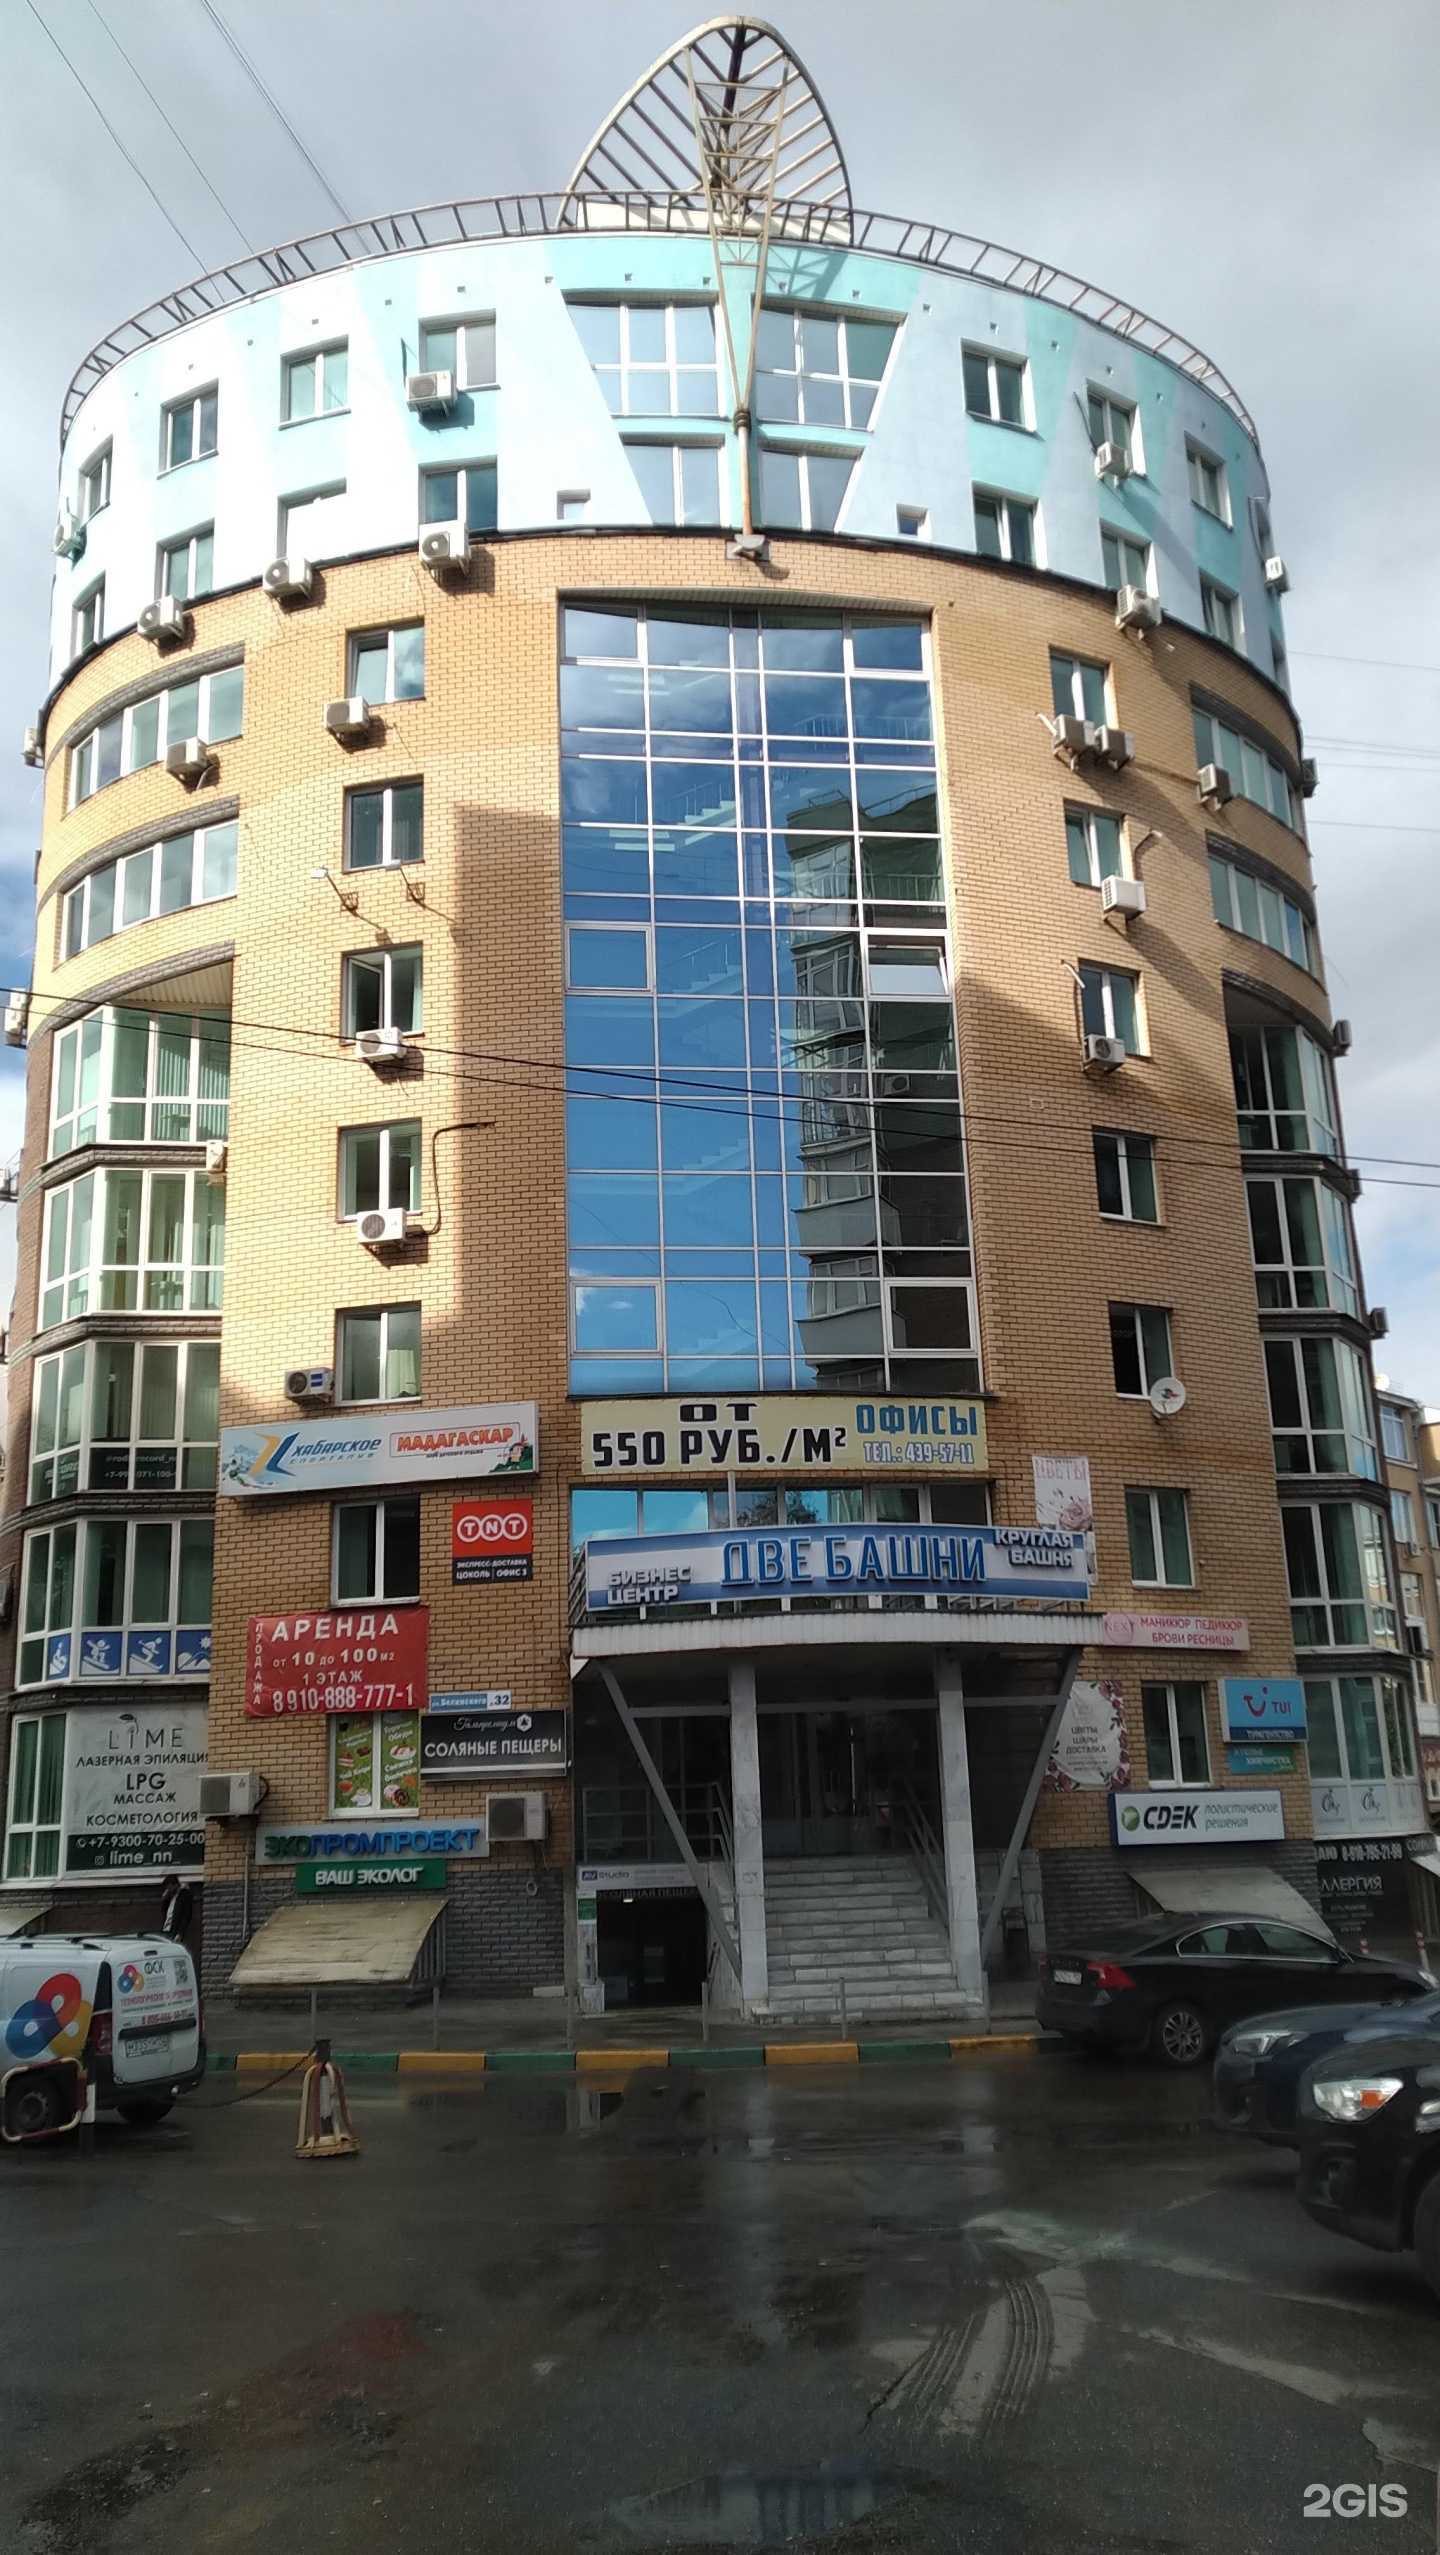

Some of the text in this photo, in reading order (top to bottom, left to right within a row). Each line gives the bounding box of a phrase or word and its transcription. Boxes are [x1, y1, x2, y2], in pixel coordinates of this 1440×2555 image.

[680, 1403, 757, 1422] ОТ
[856, 1405, 978, 1436] ОФИСЫ
[397, 1428, 514, 1451] МАДАГАСКАР
[593, 1431, 665, 1467] 550
[906, 1442, 975, 1464] 439-57-11
[460, 1516, 524, 1539] TNT
[994, 1529, 1074, 1548] КРУГЛАЯ
[720, 1534, 988, 1586] ДВЕ БАШНИ
[1010, 1548, 1073, 1567] БАШНЯ
[456, 1570, 490, 1580] ЦОКОЛЬ
[496, 1568, 520, 1577] ОФИС
[608, 1566, 692, 1587] БИЗНЕС
[606, 1584, 680, 1605] ЦЕНТР
[272, 1614, 399, 1642] АРЕНДА
[1140, 1617, 1242, 1631] МАНИКЮР ПЕДИКЮР
[1152, 1633, 1234, 1647] БРОВИ РЕСНИЦЫ
[253, 1622, 264, 1705] ПРОДАЖА
[292, 1651, 316, 1667] 10
[320, 1656, 335, 1666] до
[340, 1648, 378, 1664] 100
[303, 1670, 363, 1685] 1 ЭТАЖ
[495, 1695, 510, 1706] 32
[1272, 1702, 1292, 1713] TUI
[109, 1728, 183, 1749] LIME
[425, 1738, 561, 1757] СОЛЯНЫЕ ПЕЩЕРЫ
[76, 1755, 140, 1767] ЛАЗЕРНАЯ
[126, 1772, 166, 1790] LPG
[113, 1792, 176, 1804] МАССАЖ
[86, 1812, 198, 1826] КОСМЕТОЛОГИЯ
[89, 1833, 205, 1848] +7-9300-70-25-00
[264, 1828, 480, 1858] ЭКОПРОМПРОЕКТ
[315, 1866, 424, 1887] ВАШ ЭКОЛОГ
